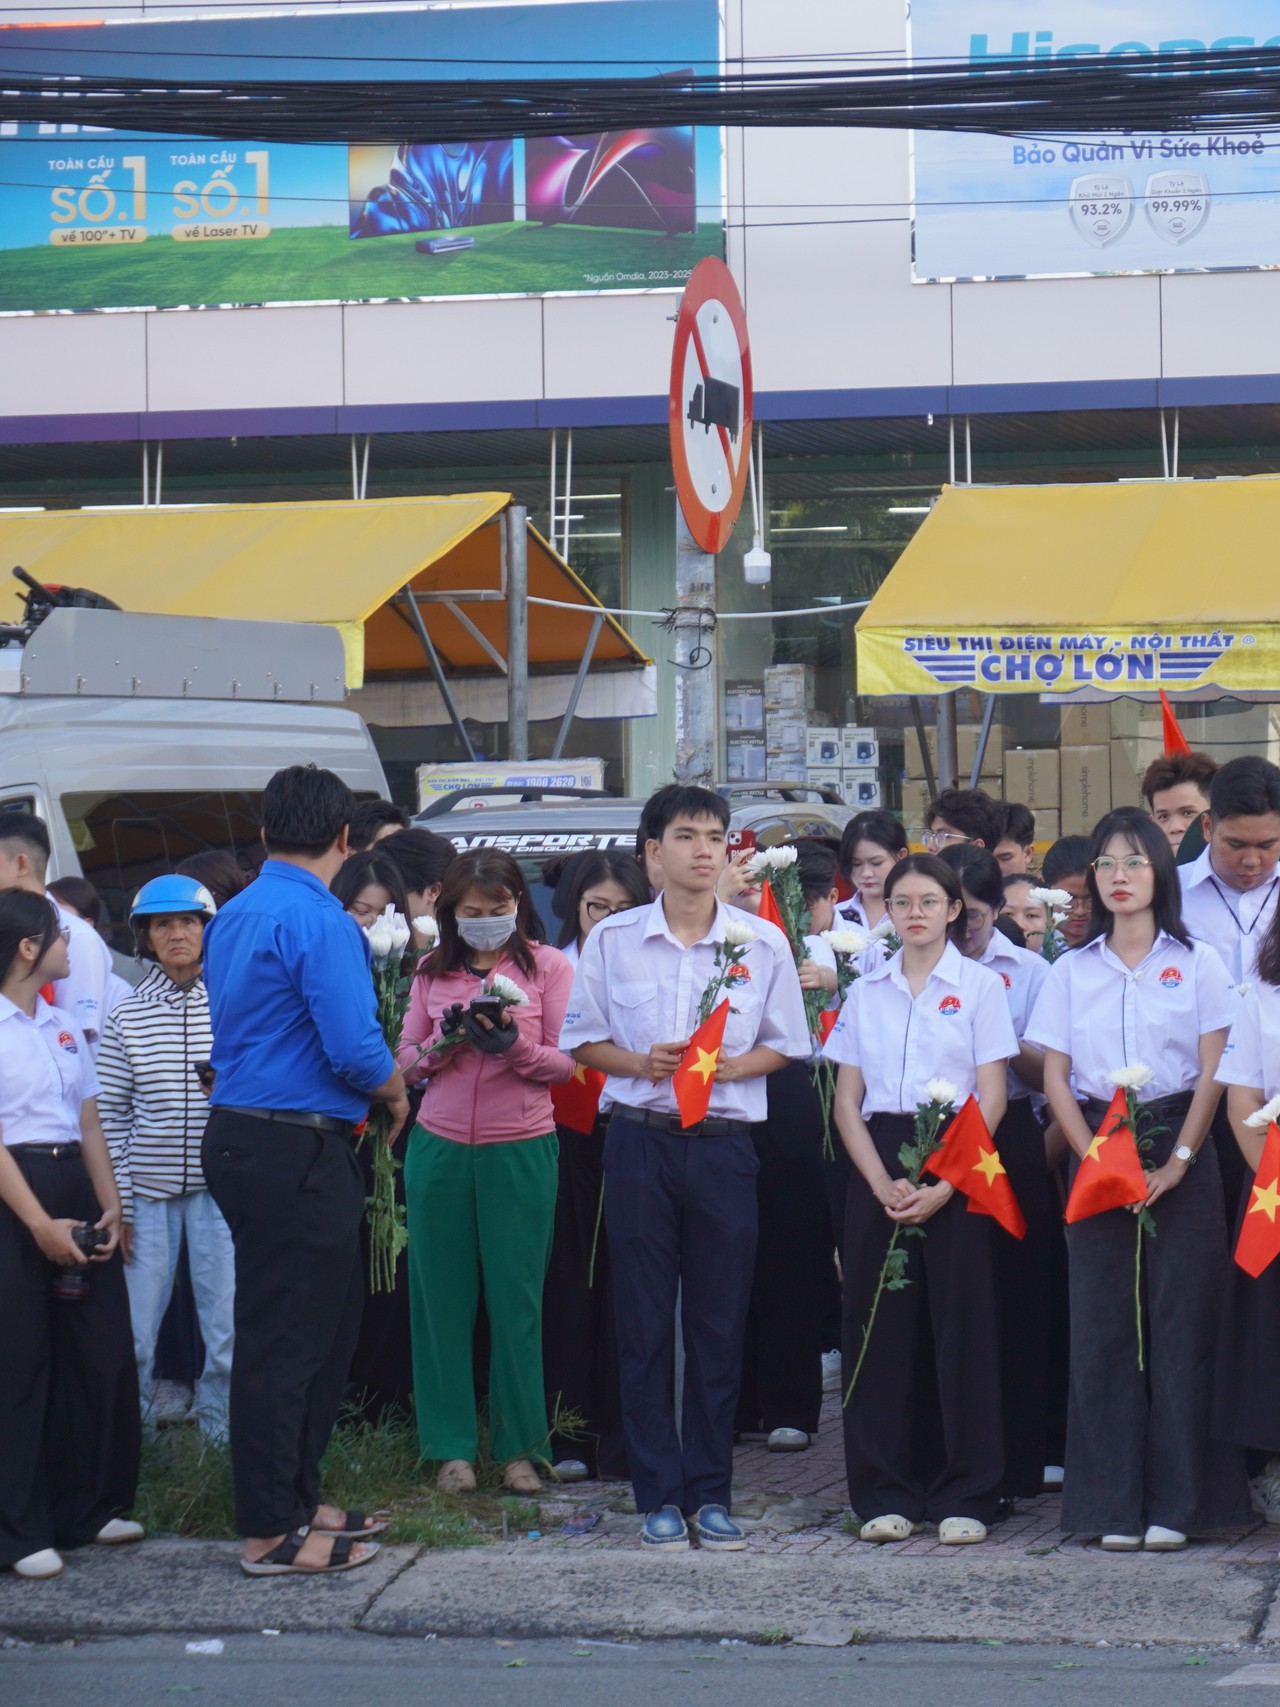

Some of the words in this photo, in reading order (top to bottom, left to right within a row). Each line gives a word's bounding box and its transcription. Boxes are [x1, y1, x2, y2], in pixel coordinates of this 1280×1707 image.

[1013, 143, 1055, 165] Bảo
[1062, 139, 1125, 163] Quản
[1159, 136, 1200, 158] Sức
[47, 157, 84, 171] TOÀN
[169, 152, 206, 166] TOÀN
[1081, 202, 1122, 216] 93.2%
[1152, 199, 1202, 213] 99.99%
[119, 229, 137, 240] TV
[203, 224, 237, 237] Laser
[241, 224, 258, 236] TV
[616, 271, 647, 281] Omdia,
[904, 634, 951, 652] SIÊU
[957, 635, 993, 656] THỊ
[999, 634, 1053, 653] ĐIỆN
[1059, 632, 1107, 651] MÁY
[1131, 633, 1175, 653] NỘI
[1180, 629, 1235, 648] THẤT
[980, 652, 1065, 687] CHỢ
[1073, 648, 1155, 682] LỚN
[526, 777, 548, 788] 1900
[550, 776, 574, 788] 2628
